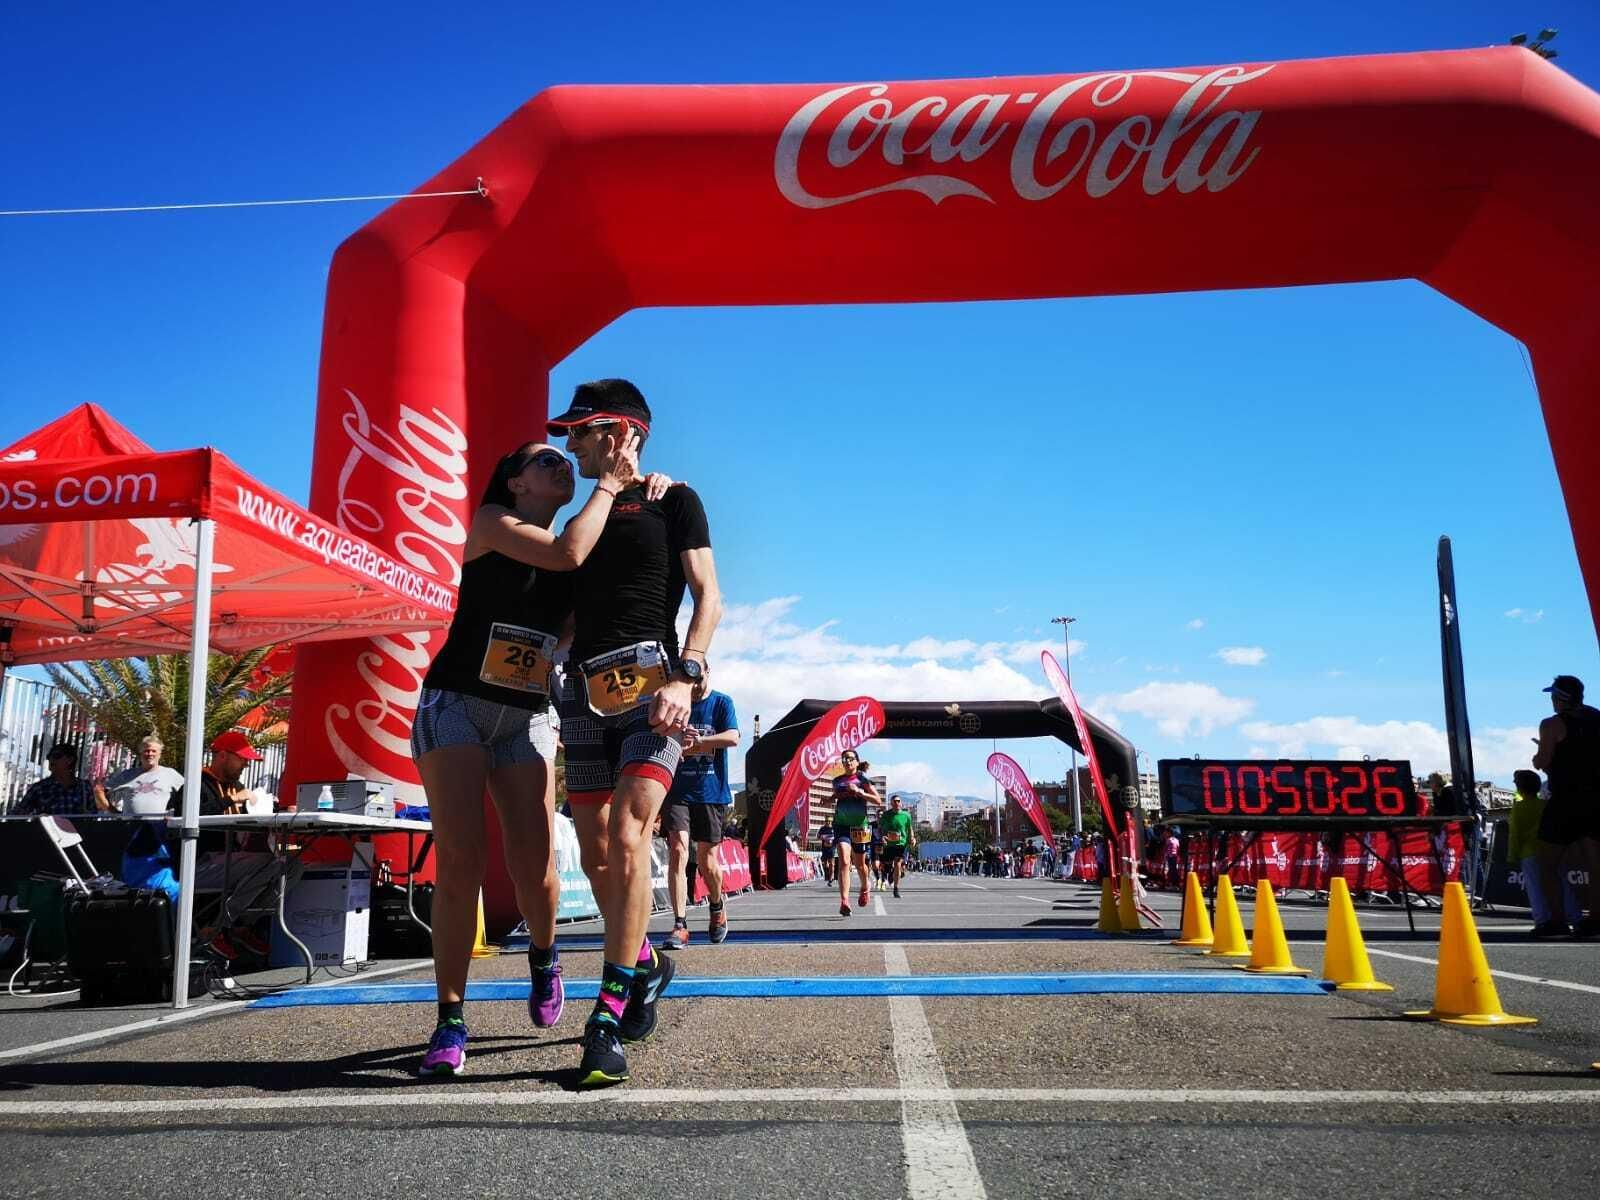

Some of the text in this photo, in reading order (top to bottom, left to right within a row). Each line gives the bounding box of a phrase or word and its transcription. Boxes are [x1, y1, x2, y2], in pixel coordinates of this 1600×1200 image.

[774, 64, 1276, 209] Coca-Cola
[236, 485, 455, 611] www.aqueatacamos.com
[503, 646, 537, 669] 26
[602, 665, 637, 694] 25
[1202, 766, 1405, 815] 00:50:26
